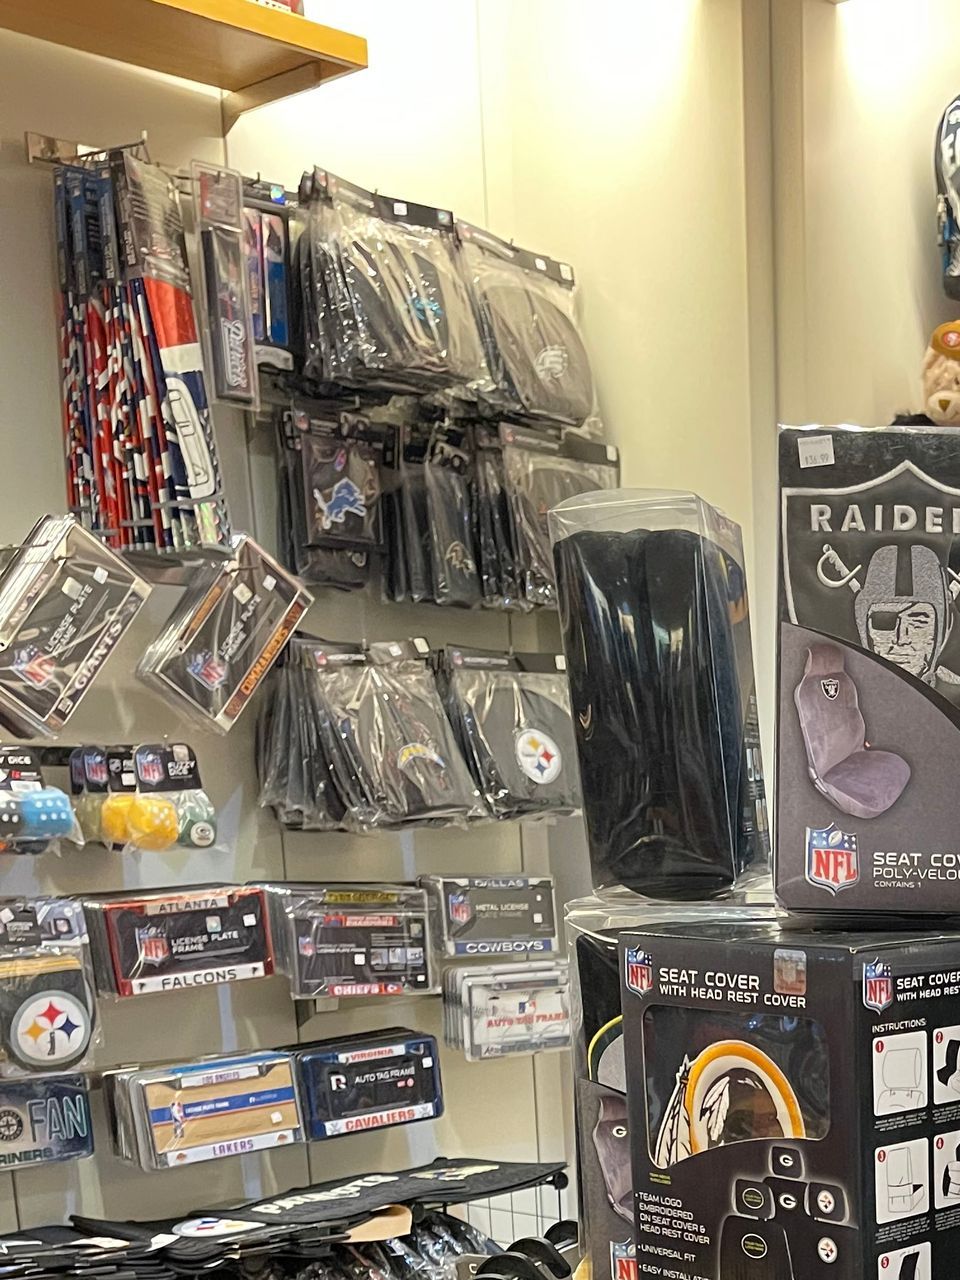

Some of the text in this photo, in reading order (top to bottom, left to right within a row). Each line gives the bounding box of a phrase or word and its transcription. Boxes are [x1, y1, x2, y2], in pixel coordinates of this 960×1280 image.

[44, 612, 74, 653] LICENSE
[74, 621, 122, 690] GIANTS
[240, 624, 289, 696] COMMANDERS
[812, 850, 859, 885] NFL
[872, 852, 922, 867] SEAT
[473, 878, 525, 889] DALLAS
[873, 879, 915, 889] CONTAINS
[158, 897, 220, 913] ATLANTA
[499, 902, 530, 911] LICENSE
[170, 929, 240, 947] LICENSE PLATE
[171, 942, 205, 953] FRAME
[465, 940, 544, 953] COWBOYS
[161, 968, 238, 990] FALCONS
[629, 963, 654, 991] NFL
[658, 967, 760, 991] SEAT COVER
[896, 976, 924, 990] SEAT
[333, 984, 380, 995] CHIEFS
[658, 983, 807, 1008] WITH HEAD REST COVER
[866, 979, 892, 1006] NFL
[896, 989, 918, 1002] WITH
[919, 986, 942, 999] HEAD
[350, 1047, 395, 1061] VIRGINIA
[354, 1065, 416, 1085] AUTO TAG FRAME
[26, 1094, 88, 1143] FAN
[344, 1107, 416, 1133] CAVALIERS
[211, 1139, 254, 1157] LAKERS
[251, 1174, 401, 1215] PATRIOTS
[638, 1191, 683, 1209] TEAM LOGO
[638, 1202, 694, 1221] EMBROIDERED
[638, 1212, 650, 1222] ON
[649, 1214, 671, 1229] SEAT
[672, 1218, 699, 1233] COVER
[639, 1223, 710, 1245] HEAD REST COVER
[640, 1243, 697, 1263] UNIVERSAL FIT
[642, 1263, 662, 1276] EASY
